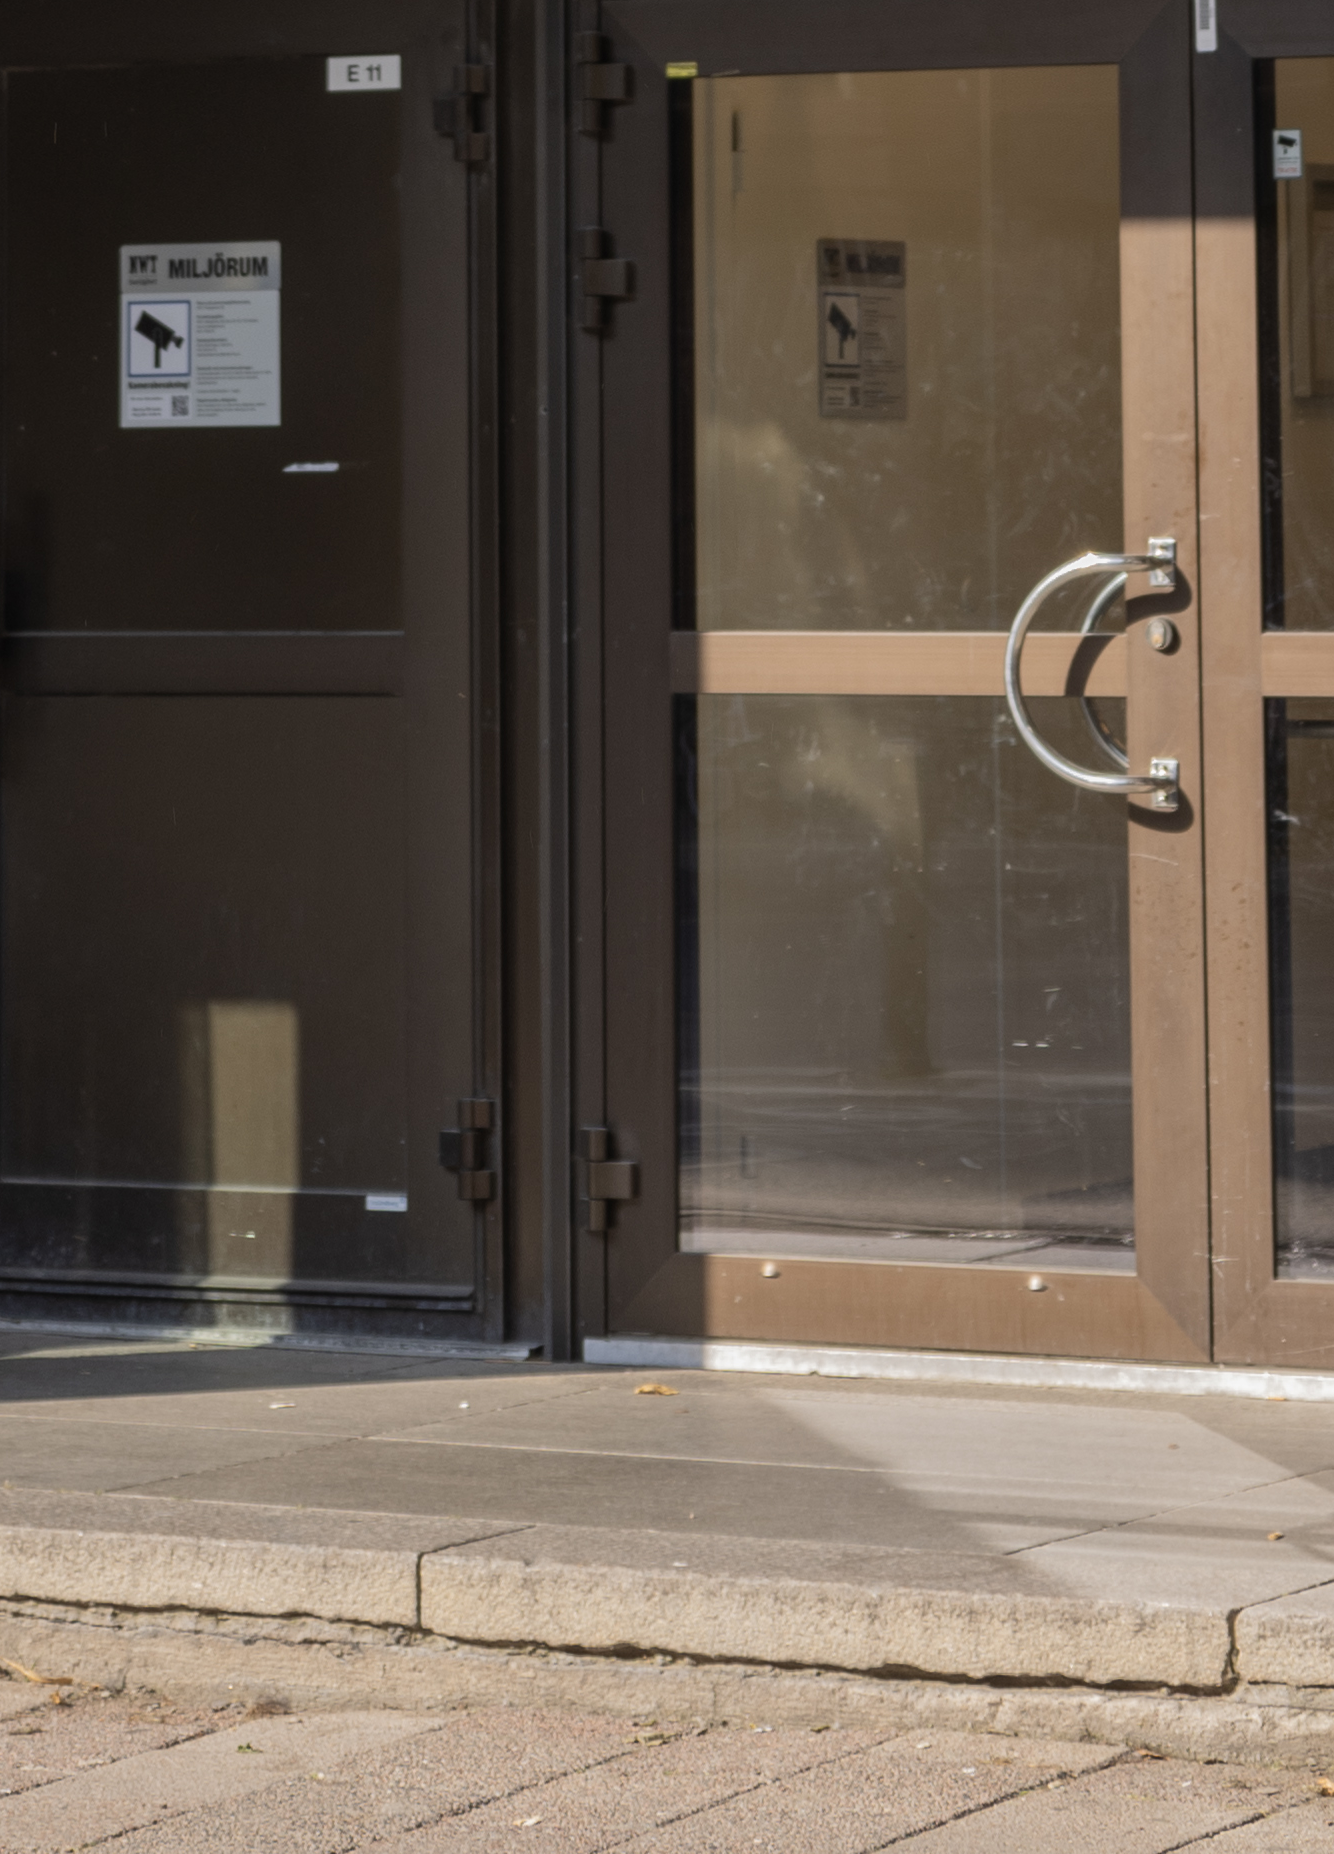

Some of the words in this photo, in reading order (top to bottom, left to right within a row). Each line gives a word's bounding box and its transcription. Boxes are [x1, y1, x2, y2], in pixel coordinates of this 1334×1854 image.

[347, 64, 360, 82] E
[366, 63, 381, 82] 11
[168, 252, 268, 278] MILJÖRUM
